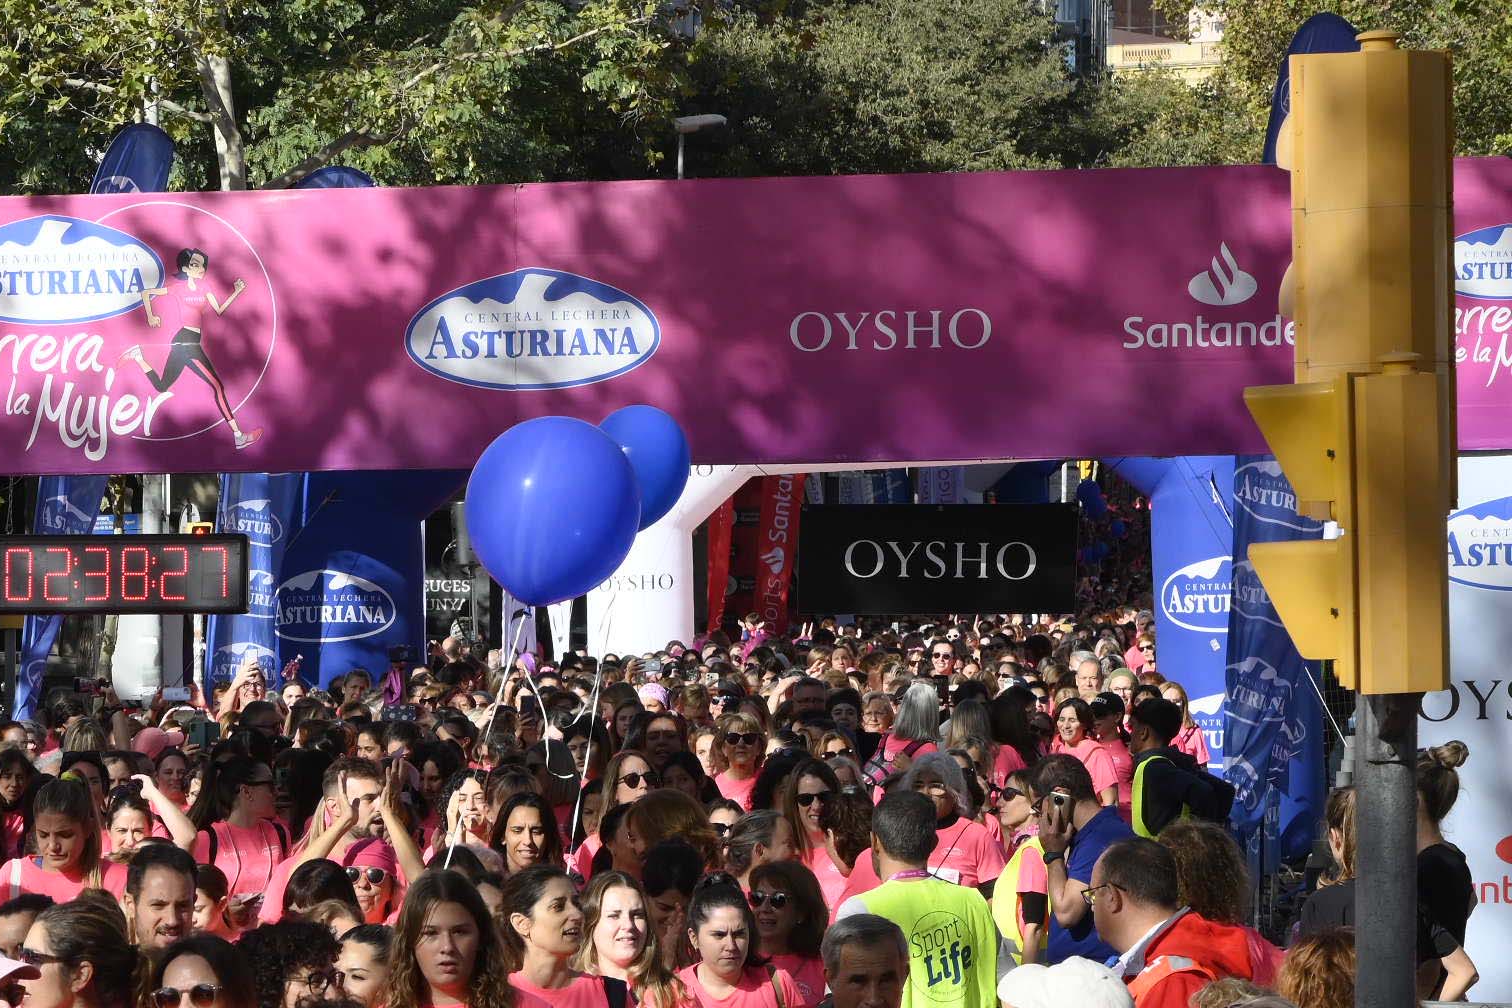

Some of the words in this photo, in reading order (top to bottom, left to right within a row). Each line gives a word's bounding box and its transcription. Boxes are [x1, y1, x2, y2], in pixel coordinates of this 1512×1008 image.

[464, 311, 543, 324] CENTRAL
[552, 308, 633, 322] LECHERA
[790, 309, 993, 352] OYSHO
[1123, 314, 1295, 349] Santande
[425, 316, 640, 360] ASTURIANA
[1472, 335, 1491, 363] la
[6, 377, 31, 416] la
[25, 367, 175, 462] Mujer
[769, 474, 793, 543] Santa
[1238, 474, 1296, 511] ASTUR
[5, 547, 227, 600] 02:38:27
[844, 540, 1037, 580] OYSHO
[599, 574, 674, 592] OYSHO
[275, 588, 386, 624] ASTURIANA
[911, 917, 962, 958] Sport
[924, 941, 972, 987] Life
